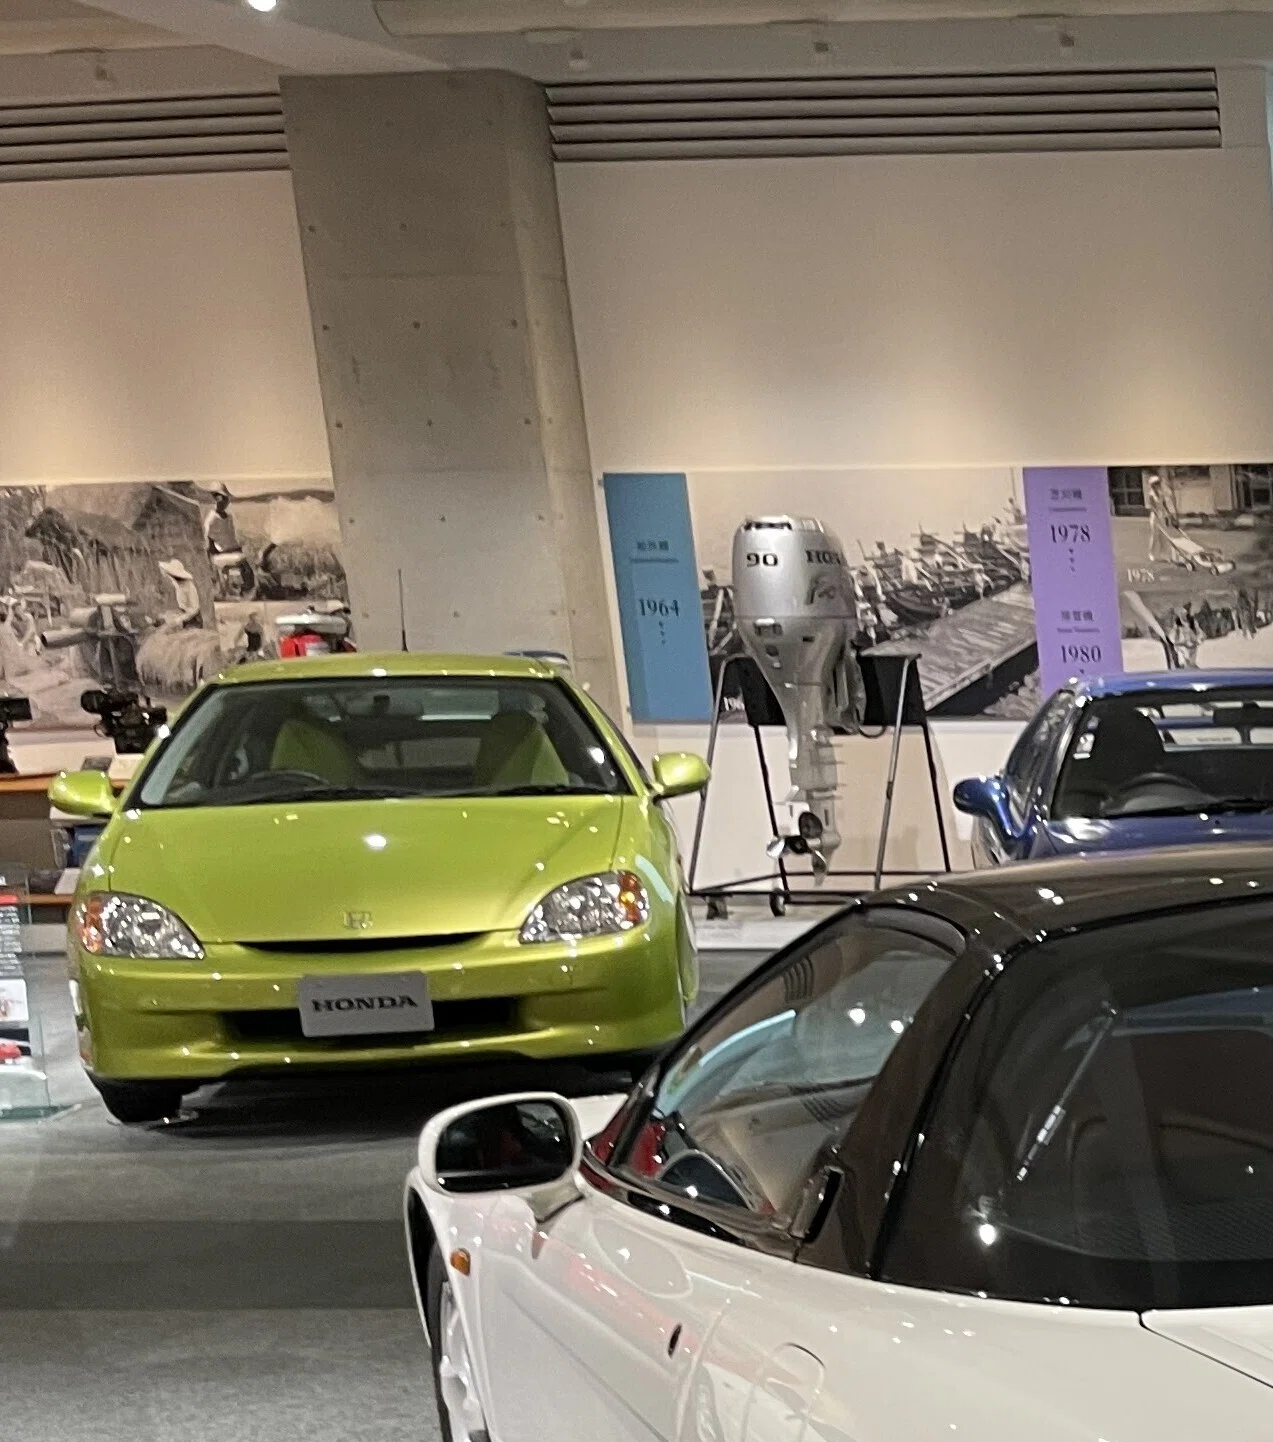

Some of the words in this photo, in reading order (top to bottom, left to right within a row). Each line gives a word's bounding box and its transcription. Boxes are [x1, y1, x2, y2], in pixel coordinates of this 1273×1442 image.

[1051, 524, 1091, 543] 1978
[746, 552, 779, 567] 90
[639, 598, 680, 616] 1964
[1060, 645, 1101, 663] 1980
[311, 995, 418, 1012] HONDA
